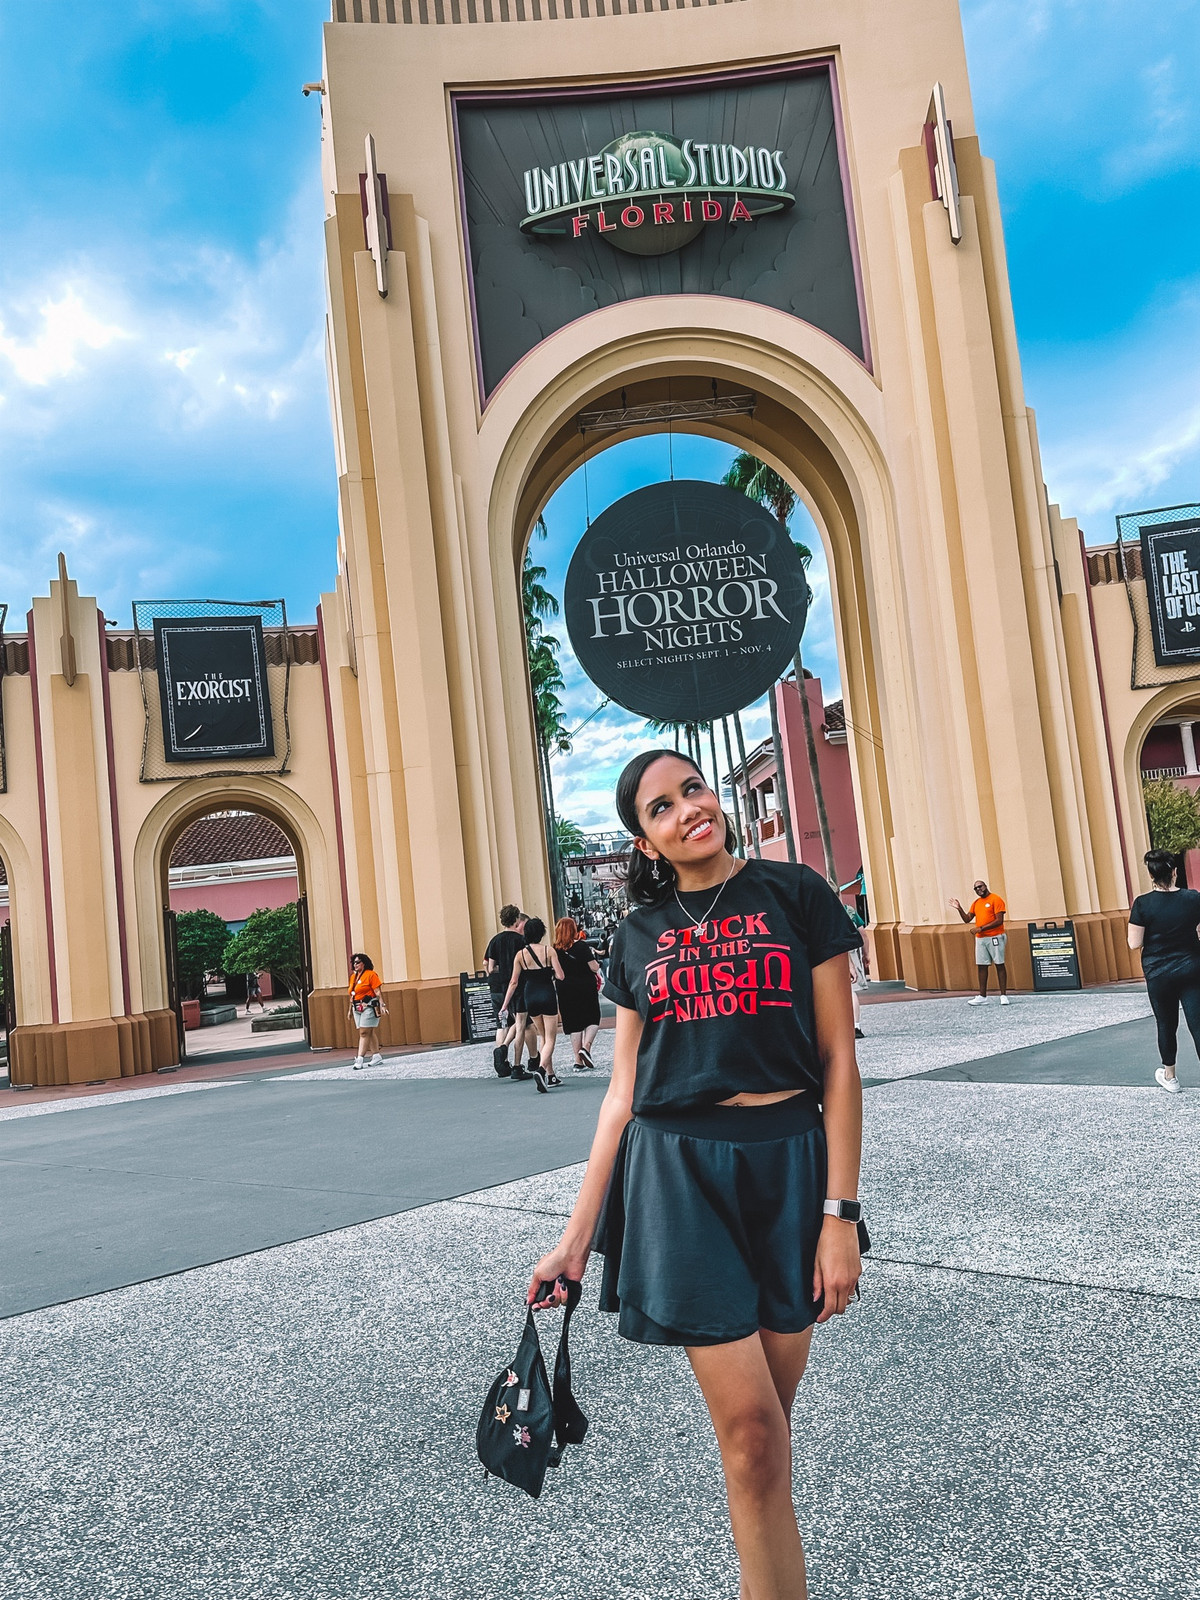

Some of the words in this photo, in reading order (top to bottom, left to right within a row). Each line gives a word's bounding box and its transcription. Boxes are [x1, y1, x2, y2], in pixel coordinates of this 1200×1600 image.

[523, 146, 677, 215] UNIVERSAL
[683, 139, 787, 190] STUDIOS
[572, 199, 753, 238] FLORIDA
[613, 547, 681, 569] Universal
[686, 540, 746, 560] Orlando
[1160, 550, 1189, 575] THE
[596, 553, 768, 595] HALLOWEEN
[1162, 570, 1199, 597] LAST
[586, 578, 791, 639] HORROR
[1165, 595, 1184, 620] OF
[643, 619, 744, 652] NIGHTS
[616, 657, 654, 669] SELECT
[656, 653, 695, 665] NIGHTS
[696, 650, 723, 660] SEPT.
[740, 645, 765, 655] NOV.
[766, 645, 772, 653] 4
[176, 678, 252, 700] EXORCIST
[204, 672, 224, 680] THE
[656, 912, 772, 953] STUCK
[678, 946, 700, 963] IN
[707, 939, 751, 959] THE
[644, 951, 793, 1006] UPSIDE
[673, 990, 758, 1023] DOWN
